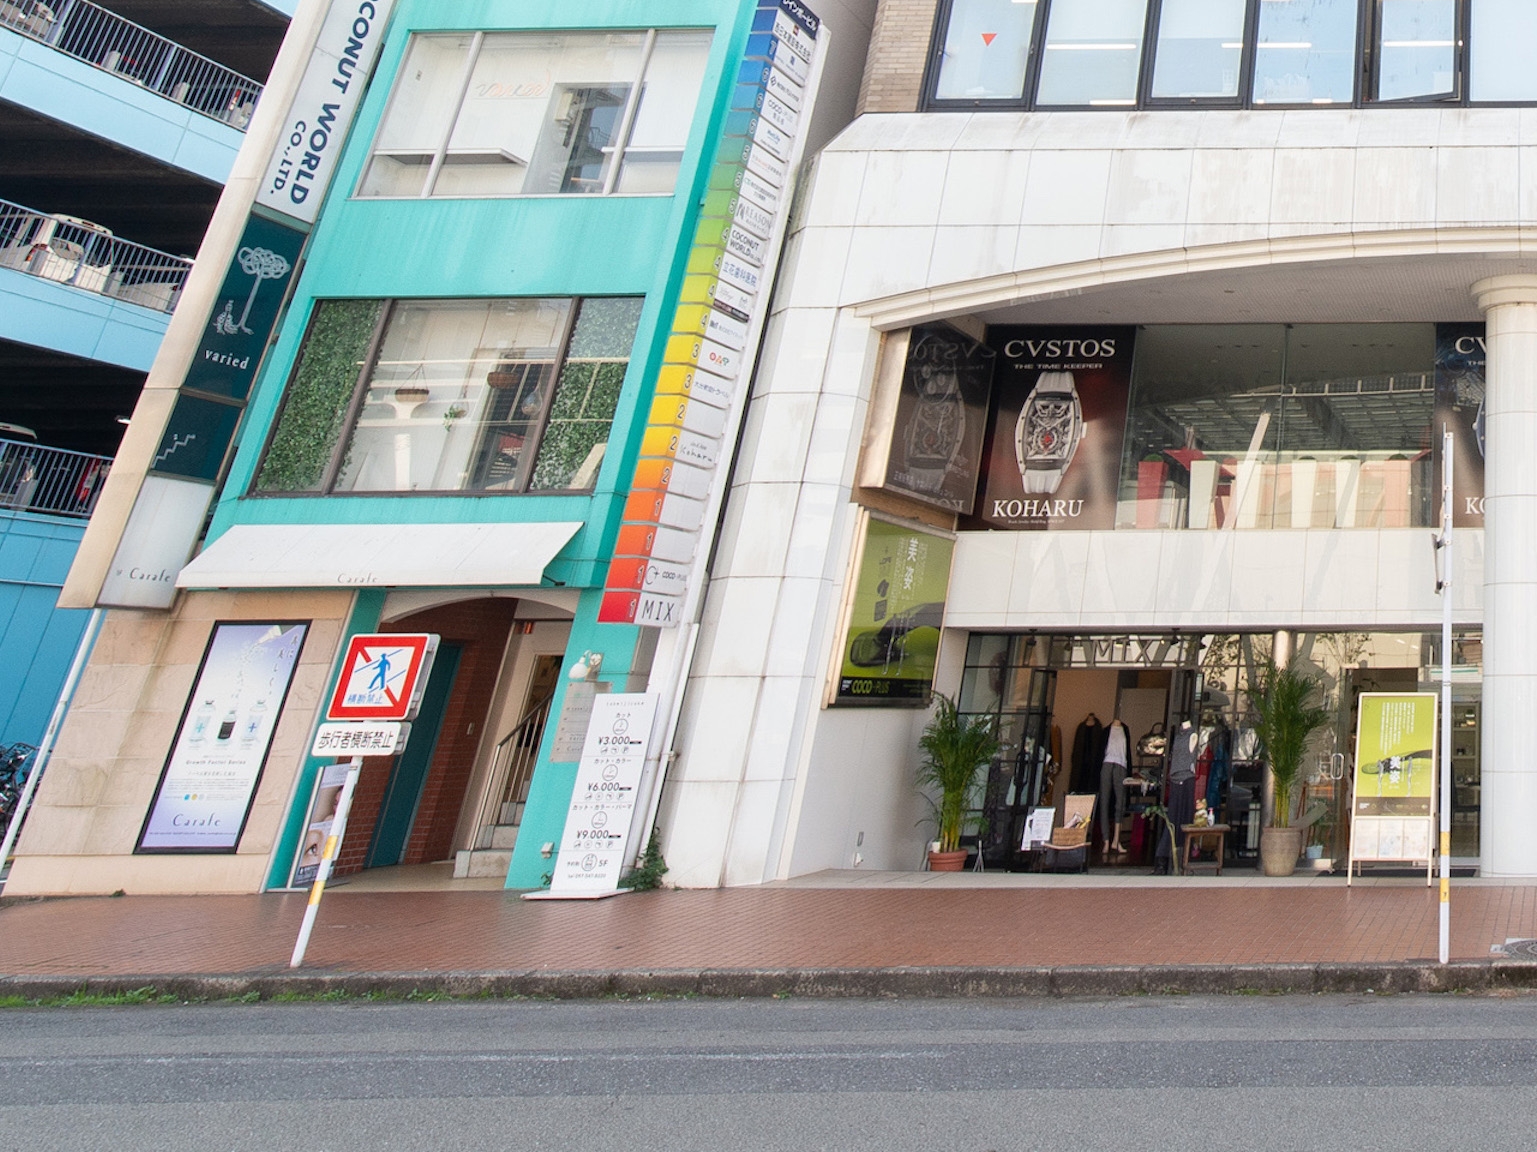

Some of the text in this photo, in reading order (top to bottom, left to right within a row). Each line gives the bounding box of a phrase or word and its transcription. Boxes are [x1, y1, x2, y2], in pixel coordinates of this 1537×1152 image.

[270, 120, 306, 195] CO.,LTD.
[290, 103, 341, 204] WORLD
[732, 229, 759, 249] COCONUT
[1004, 338, 1116, 358] CVSTOS
[204, 349, 250, 370] varied
[677, 404, 685, 419] 2
[670, 436, 677, 451] 2
[662, 468, 670, 484] 2
[992, 499, 1084, 518] KOHARU
[642, 599, 675, 622] MIX
[1092, 638, 1154, 663] MIX
[318, 730, 395, 749] 歩行者横断禁止
